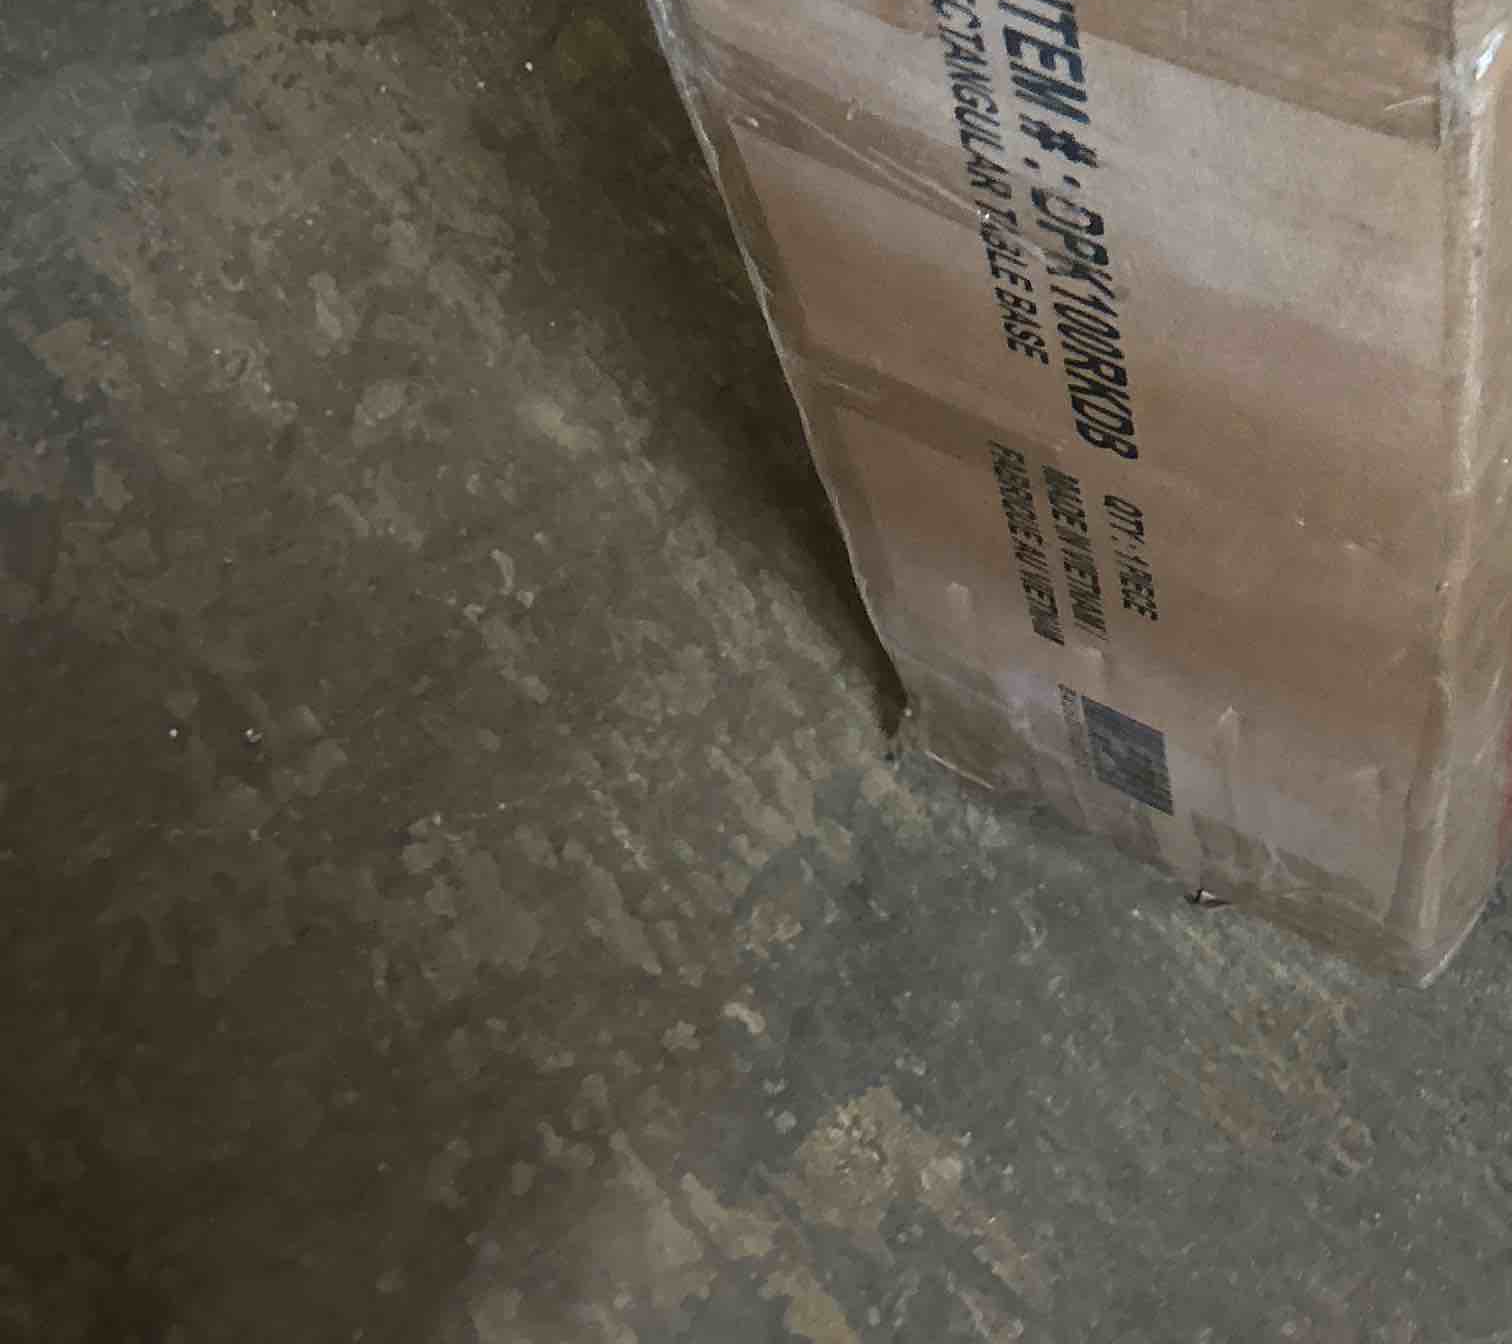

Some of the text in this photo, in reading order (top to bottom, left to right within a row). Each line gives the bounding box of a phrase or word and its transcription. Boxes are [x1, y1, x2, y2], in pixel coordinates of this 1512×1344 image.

[995, 285, 1049, 366] BASE
[1028, 183, 1139, 464] DPK100RKDB
[1042, 462, 1089, 536] MADE
[1103, 491, 1147, 546] QTY
[1012, 536, 1050, 575] AU
[1055, 524, 1093, 554] IN
[1059, 543, 1108, 633] VIETNAM
[1115, 558, 1158, 623] PIECE
